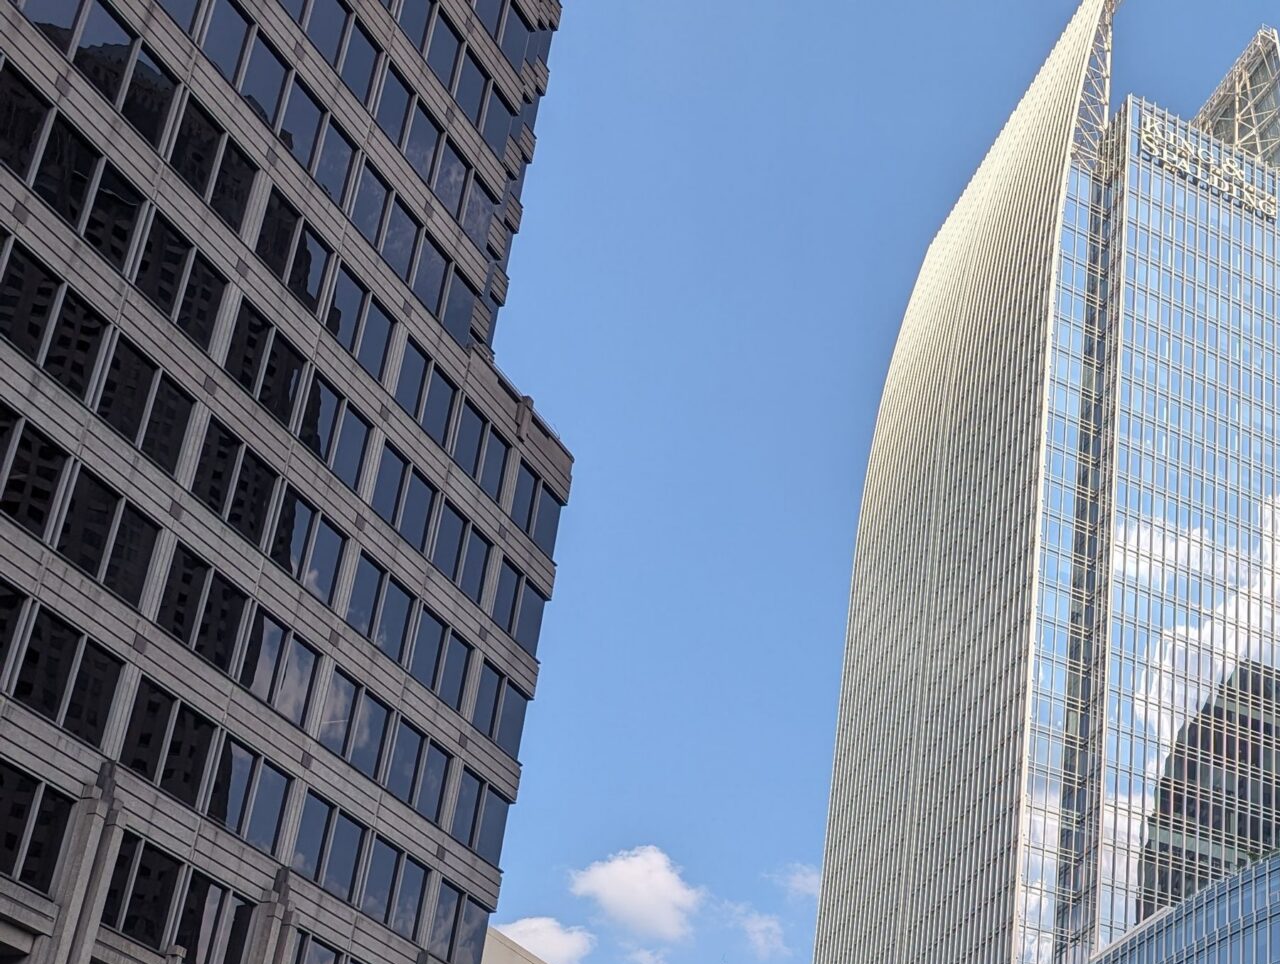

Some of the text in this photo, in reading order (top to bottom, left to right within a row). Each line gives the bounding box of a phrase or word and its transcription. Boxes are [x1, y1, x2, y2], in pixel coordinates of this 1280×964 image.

[1142, 134, 1277, 216] SPALDING
[1143, 114, 1244, 180] KING &
